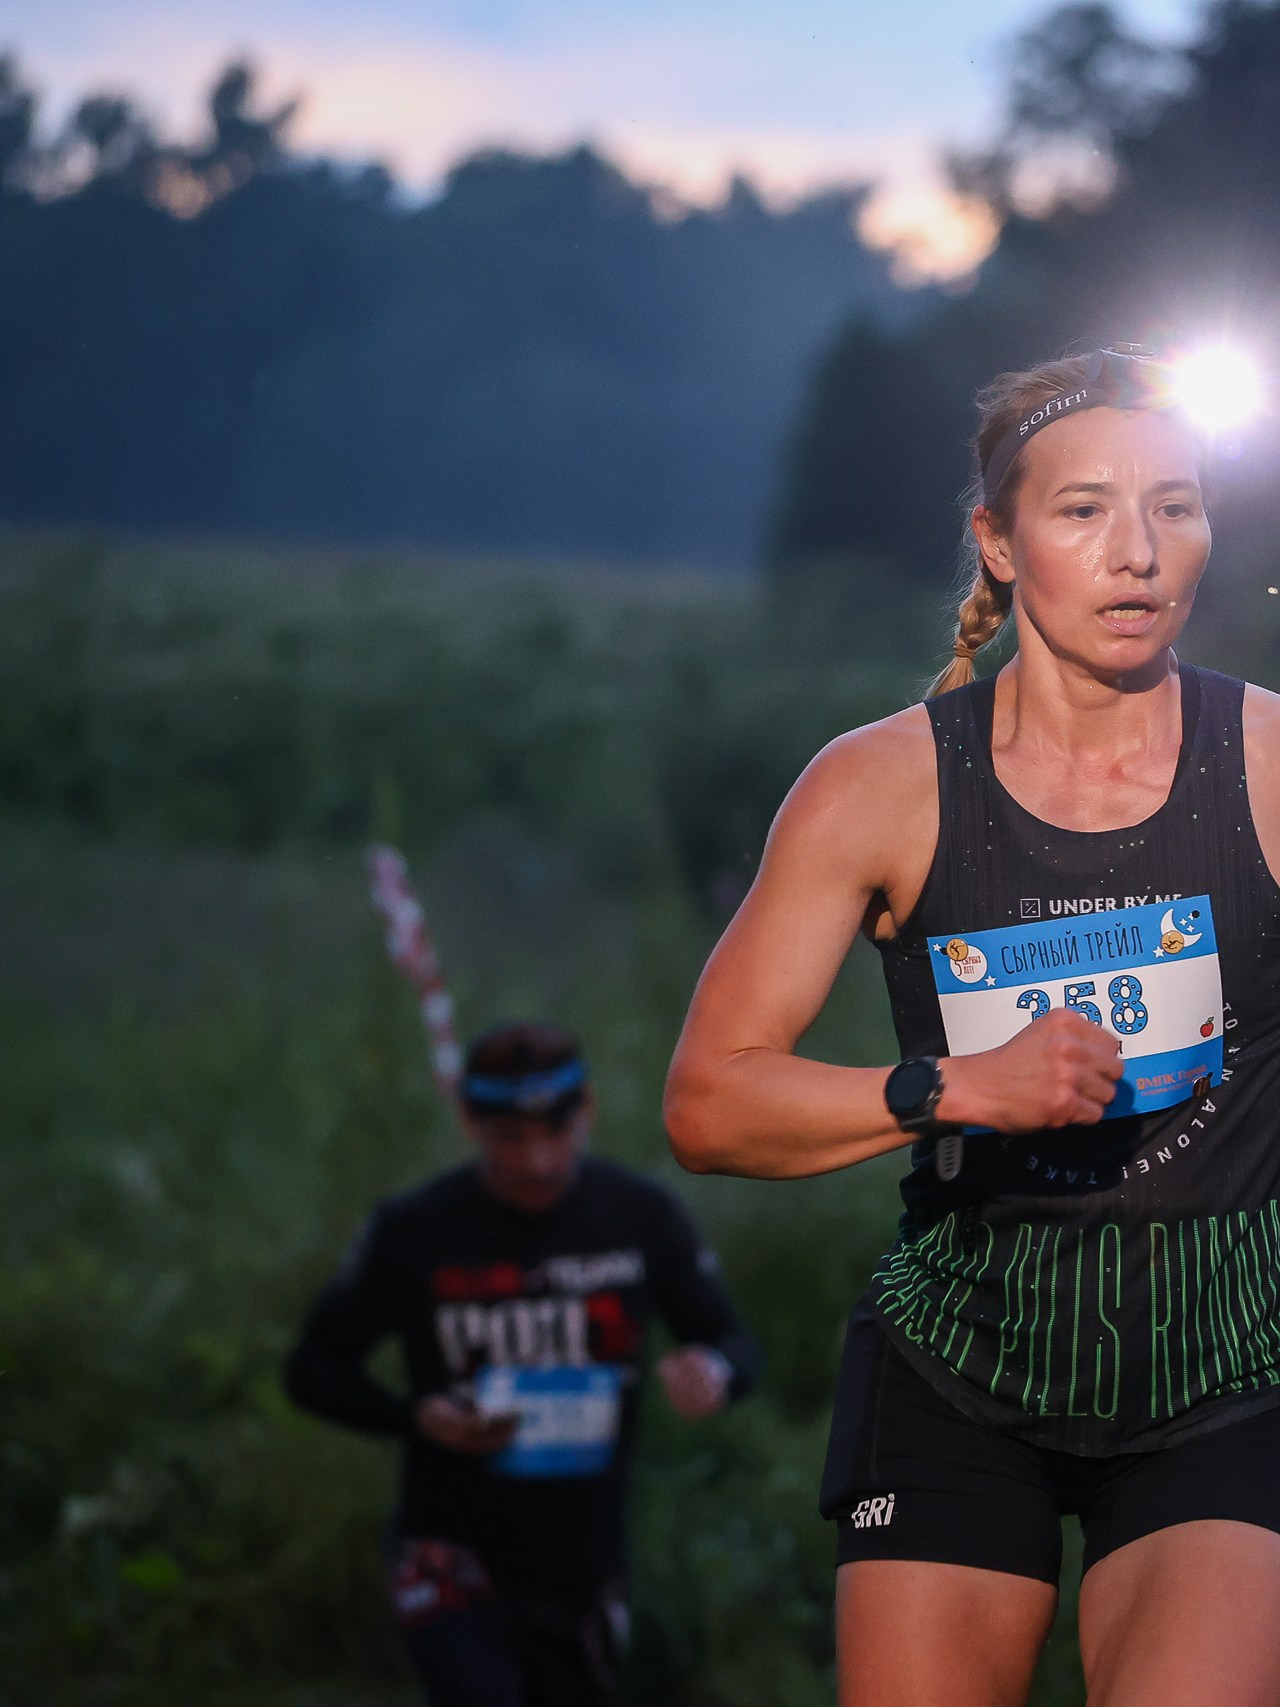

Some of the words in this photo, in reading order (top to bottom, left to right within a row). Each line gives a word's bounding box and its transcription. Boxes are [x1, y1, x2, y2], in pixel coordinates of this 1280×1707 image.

[1019, 389, 1088, 436] sofirn
[1049, 897, 1118, 915] UNDER
[1123, 894, 1149, 909] BY
[1001, 929, 1077, 975] СЫРНЫЙ
[1084, 921, 1144, 962] ТРЕЙЛ
[1121, 1098, 1217, 1180] ALONE!
[1025, 1154, 1099, 1185] TAKE
